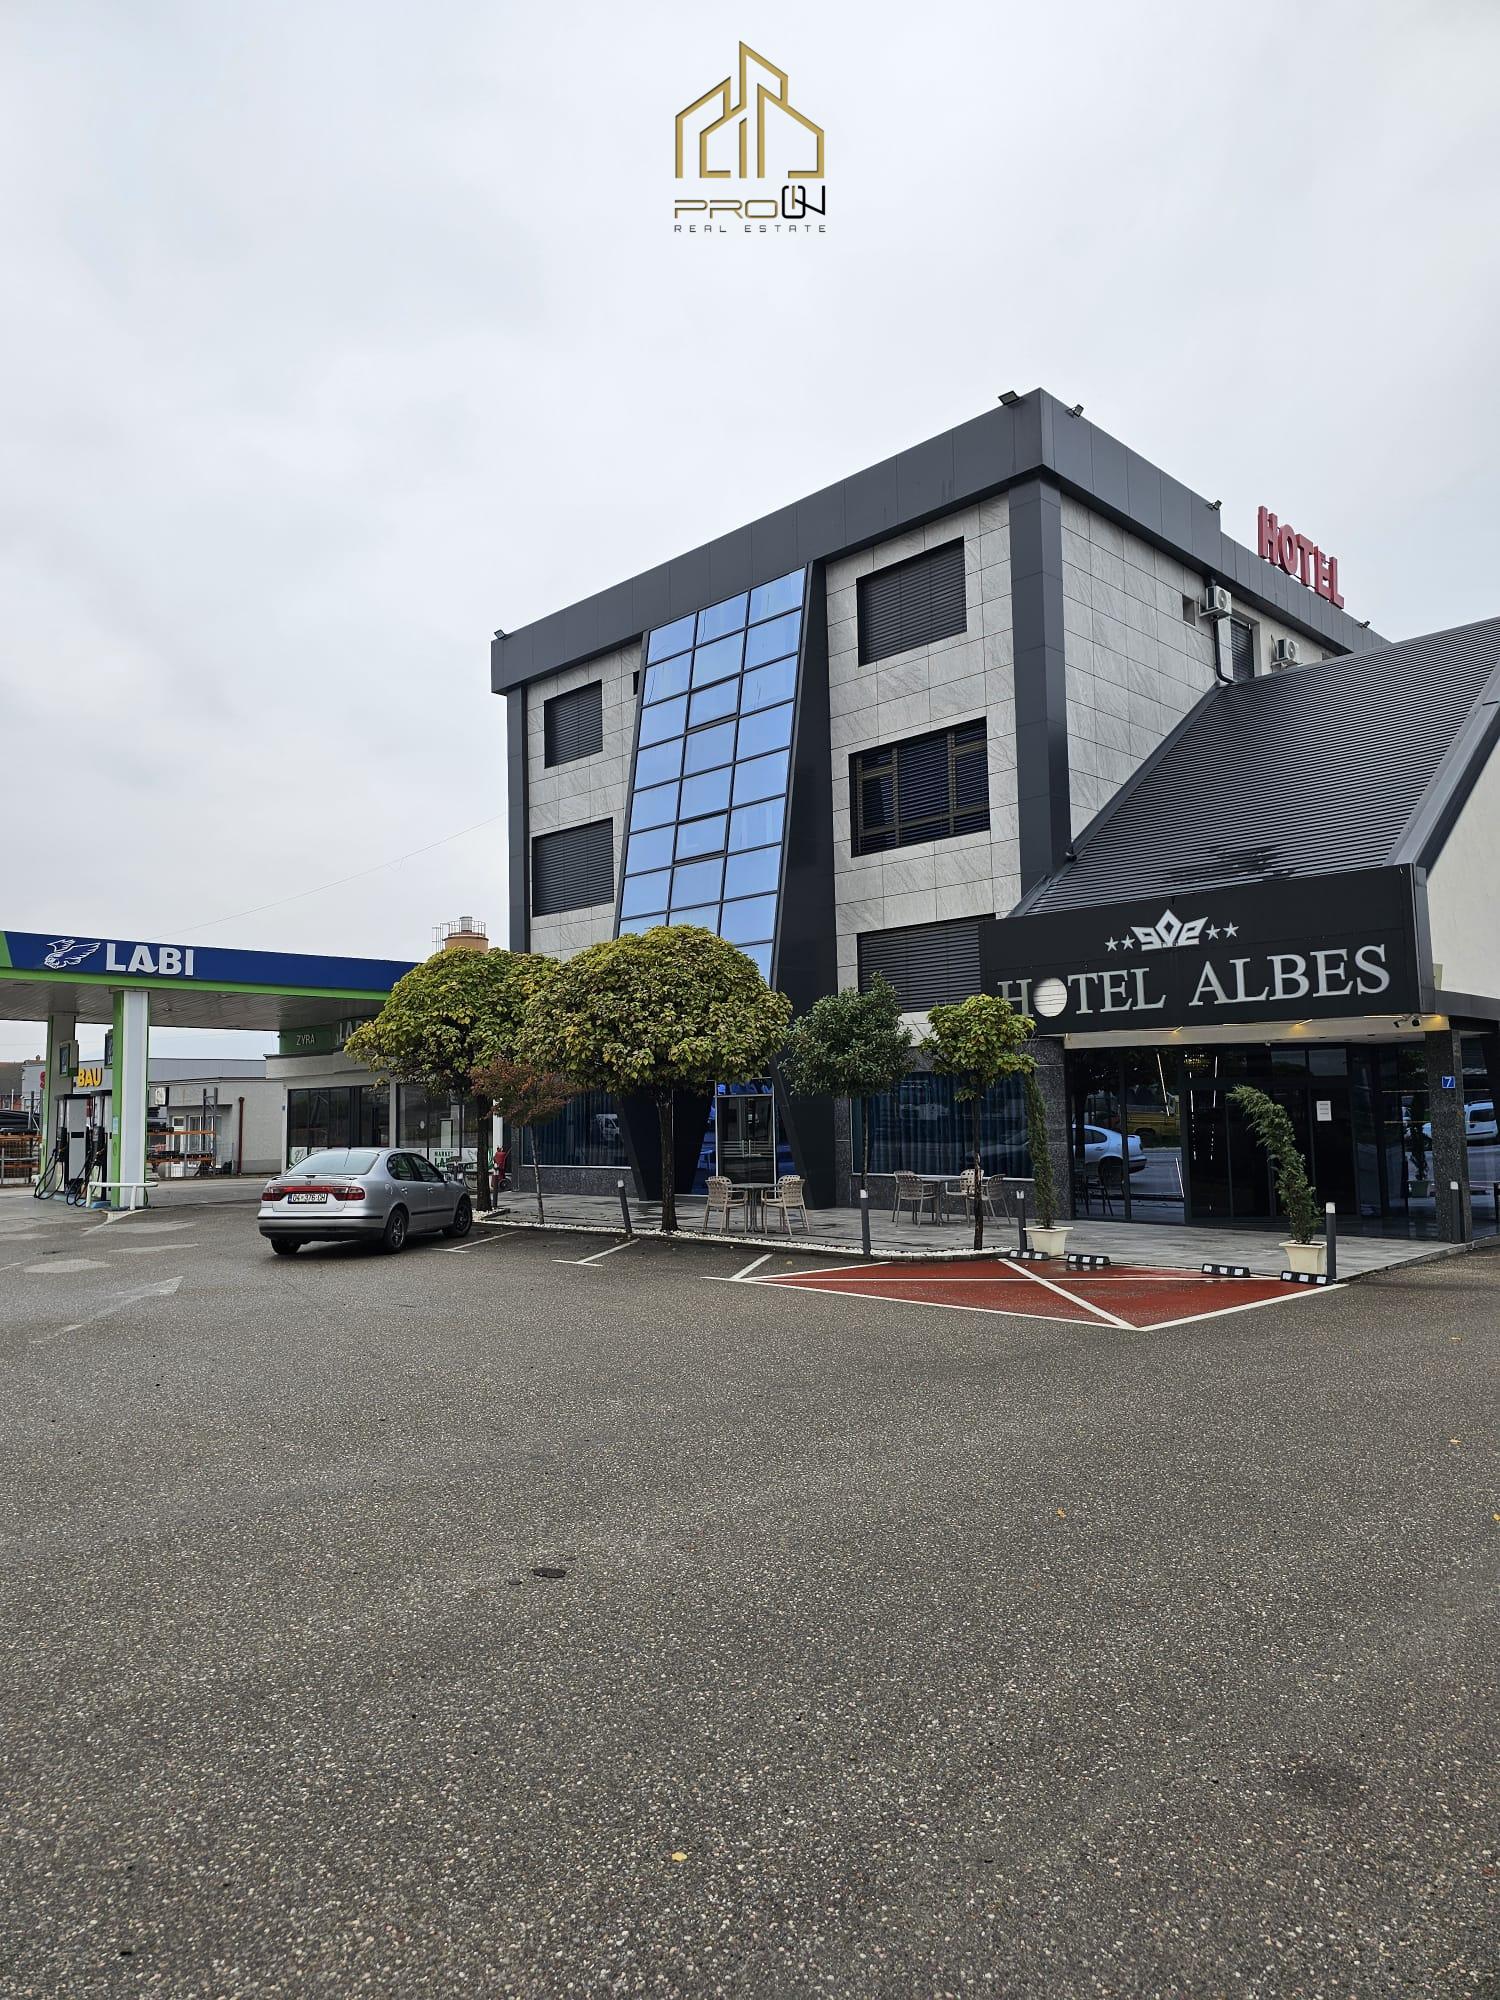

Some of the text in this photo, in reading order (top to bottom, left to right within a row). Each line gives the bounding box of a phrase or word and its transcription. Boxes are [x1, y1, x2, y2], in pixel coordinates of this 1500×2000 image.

[1257, 505, 1345, 610] HOTEL
[105, 943, 195, 976] LABI
[1188, 944, 1391, 1007] ALBES
[296, 1034, 315, 1046] ZYRA
